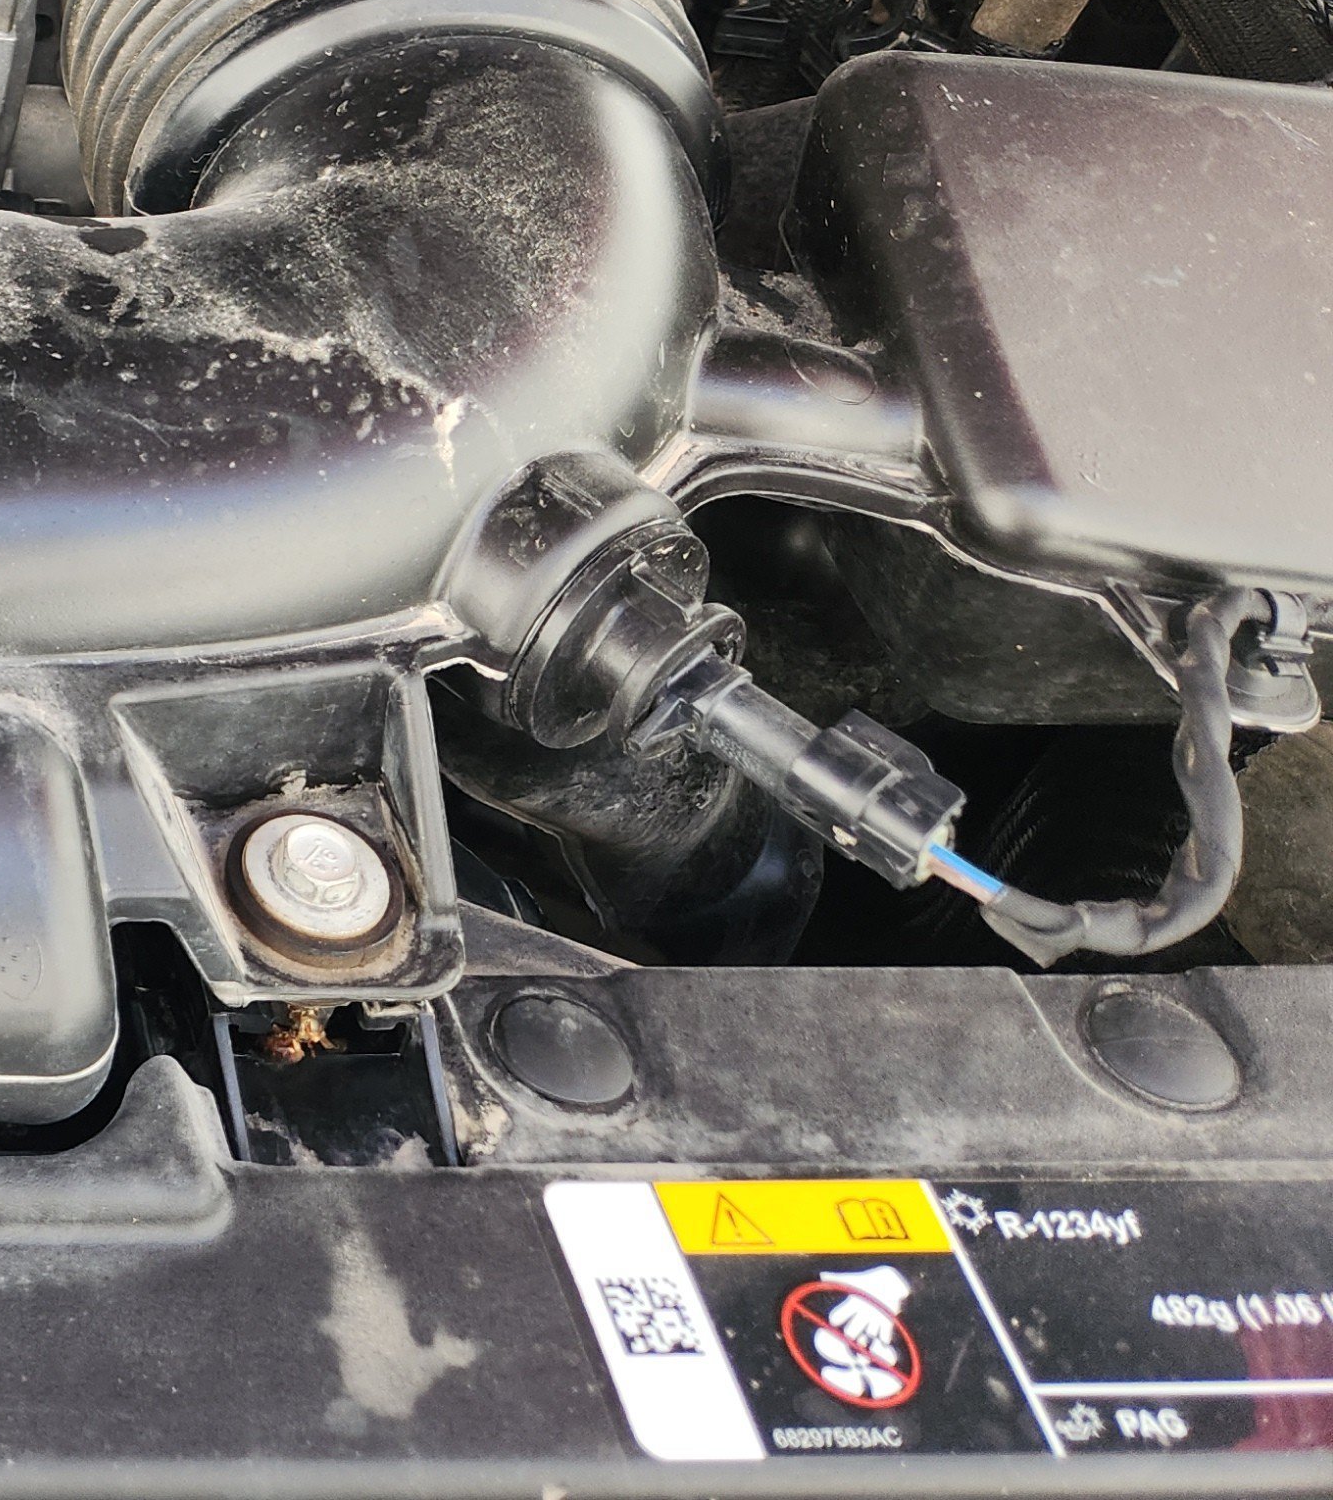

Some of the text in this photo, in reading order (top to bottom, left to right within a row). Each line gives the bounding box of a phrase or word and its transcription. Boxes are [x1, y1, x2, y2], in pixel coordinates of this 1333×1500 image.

[994, 1209, 1142, 1245] R-1234yf
[1151, 1294, 1239, 1333] 482g
[772, 1426, 903, 1449] 68297583AC
[1114, 1408, 1188, 1439] PAG
